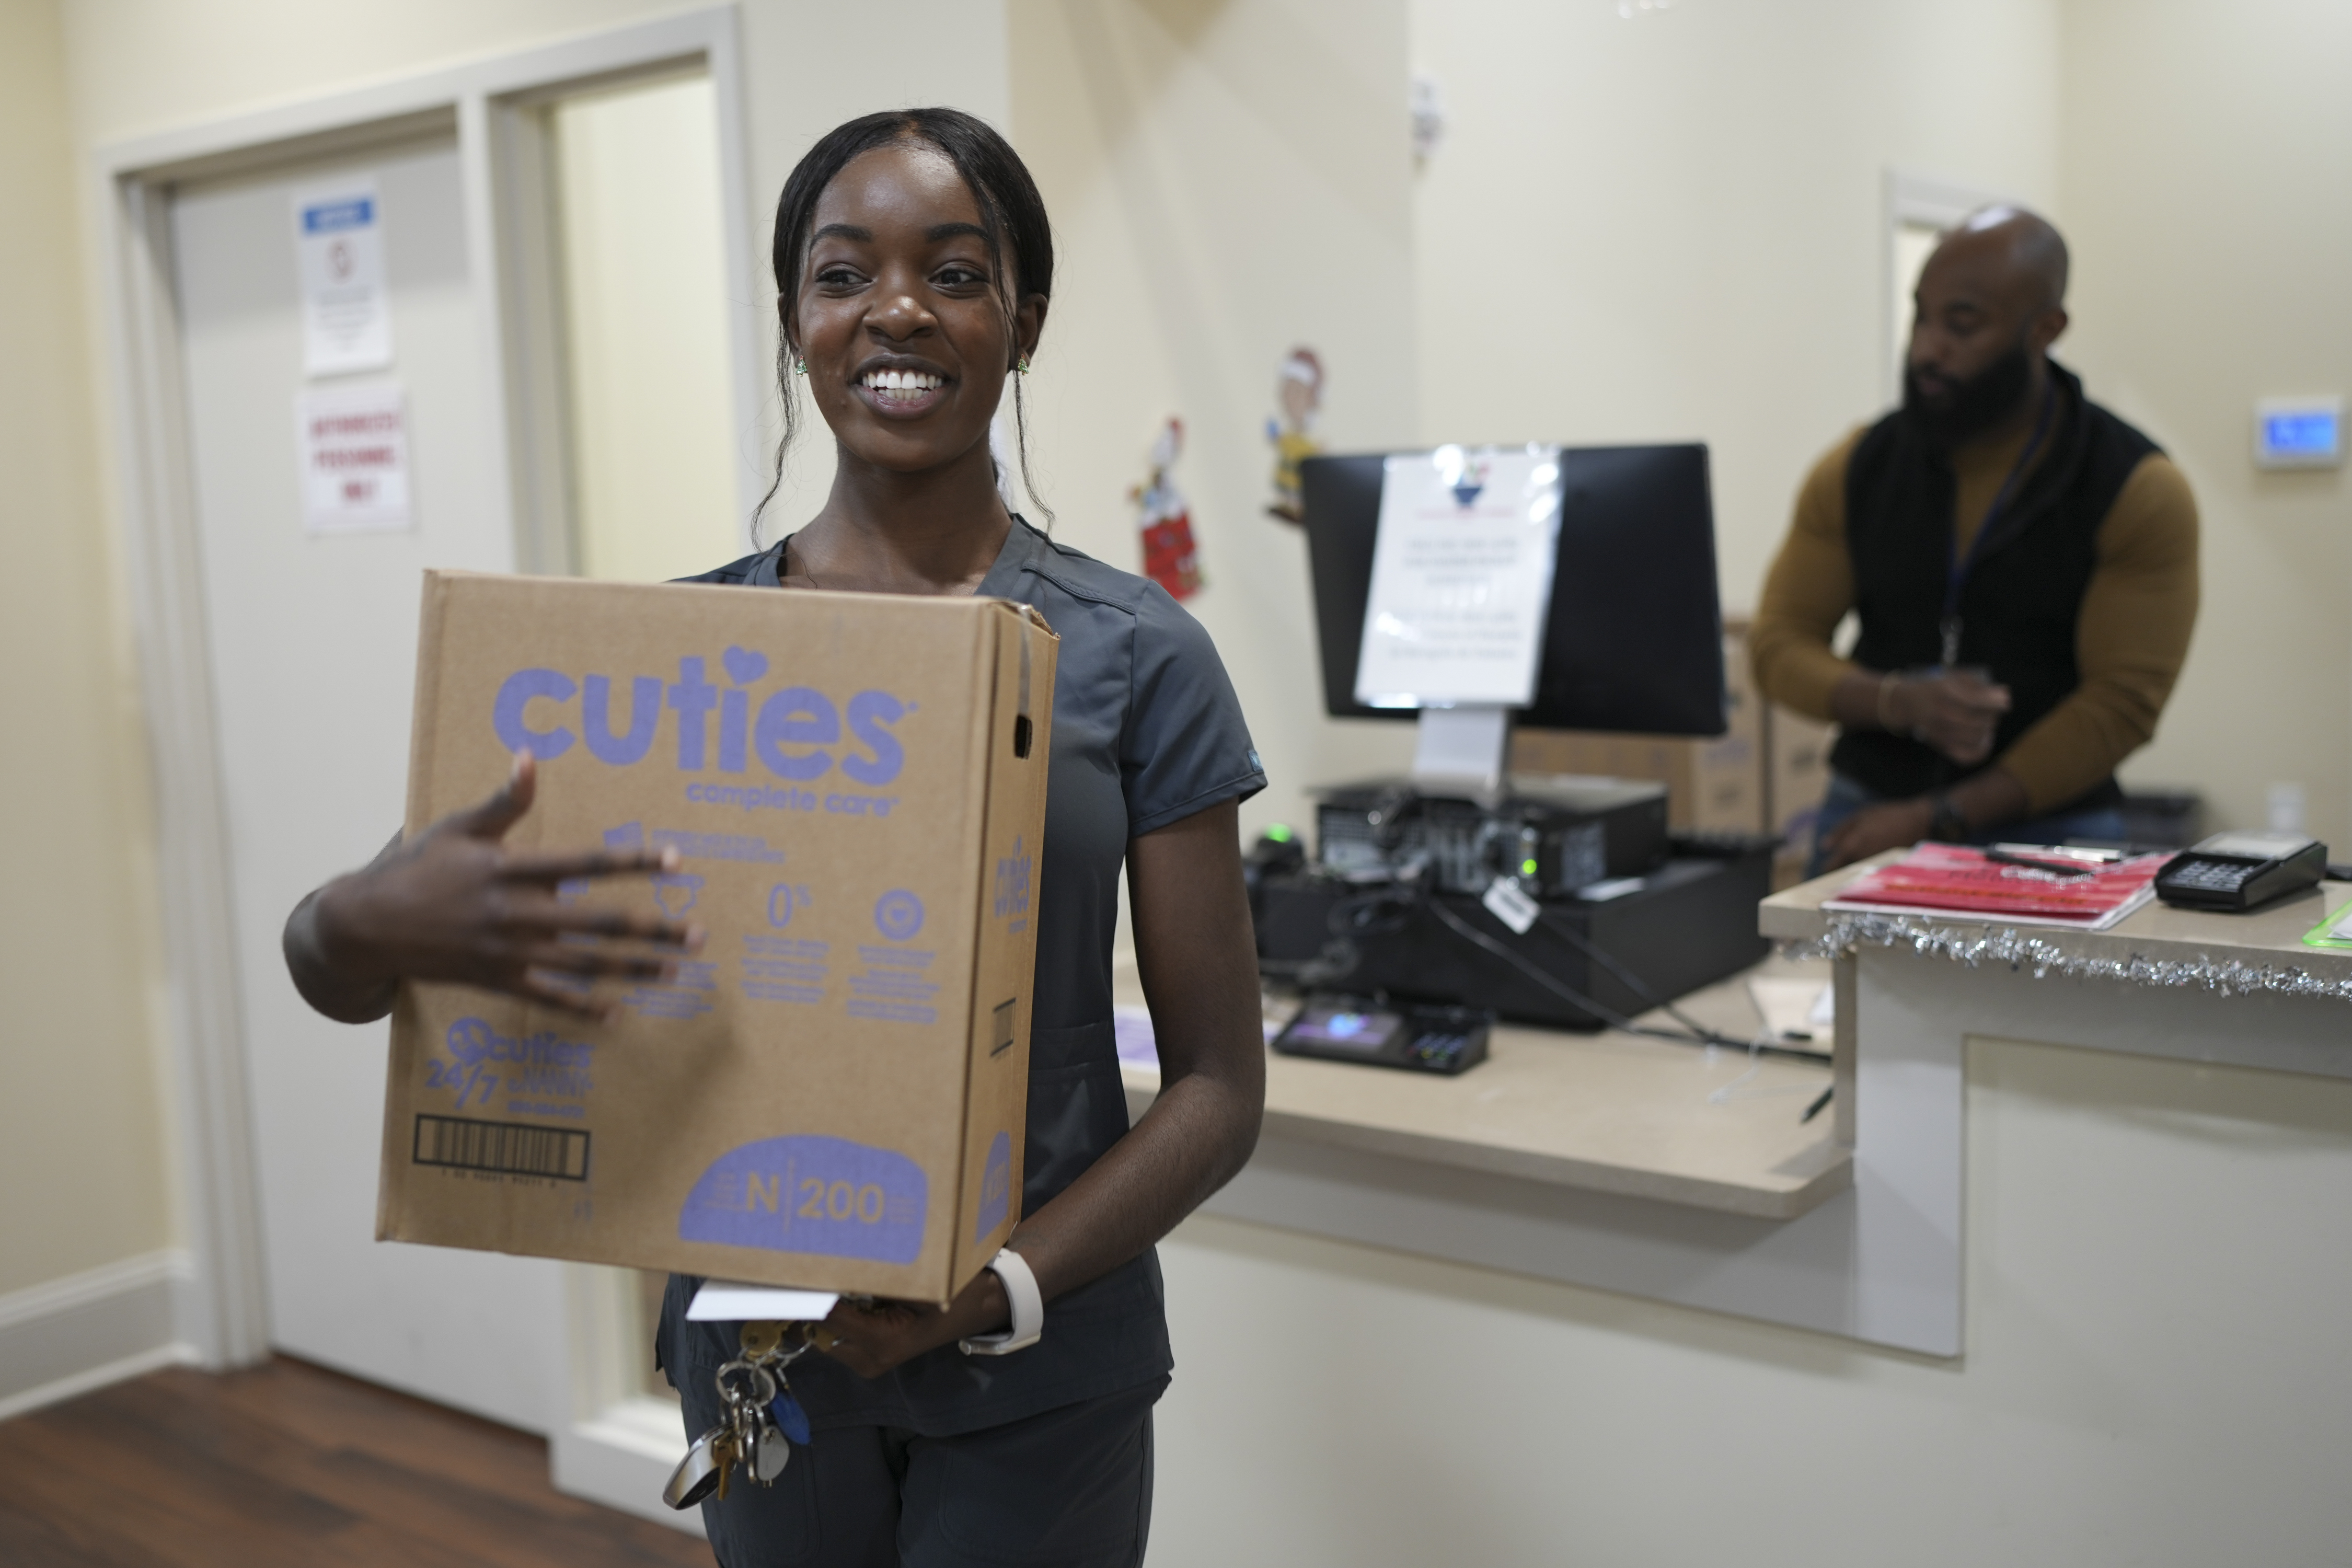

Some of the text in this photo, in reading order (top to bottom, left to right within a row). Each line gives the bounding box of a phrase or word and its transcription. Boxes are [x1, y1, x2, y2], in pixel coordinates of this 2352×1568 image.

[492, 644, 907, 787] cuties
[685, 781, 817, 811] complete
[425, 1058, 499, 1110] 24/7
[746, 1171, 780, 1214] N
[797, 1177, 885, 1224] 200
